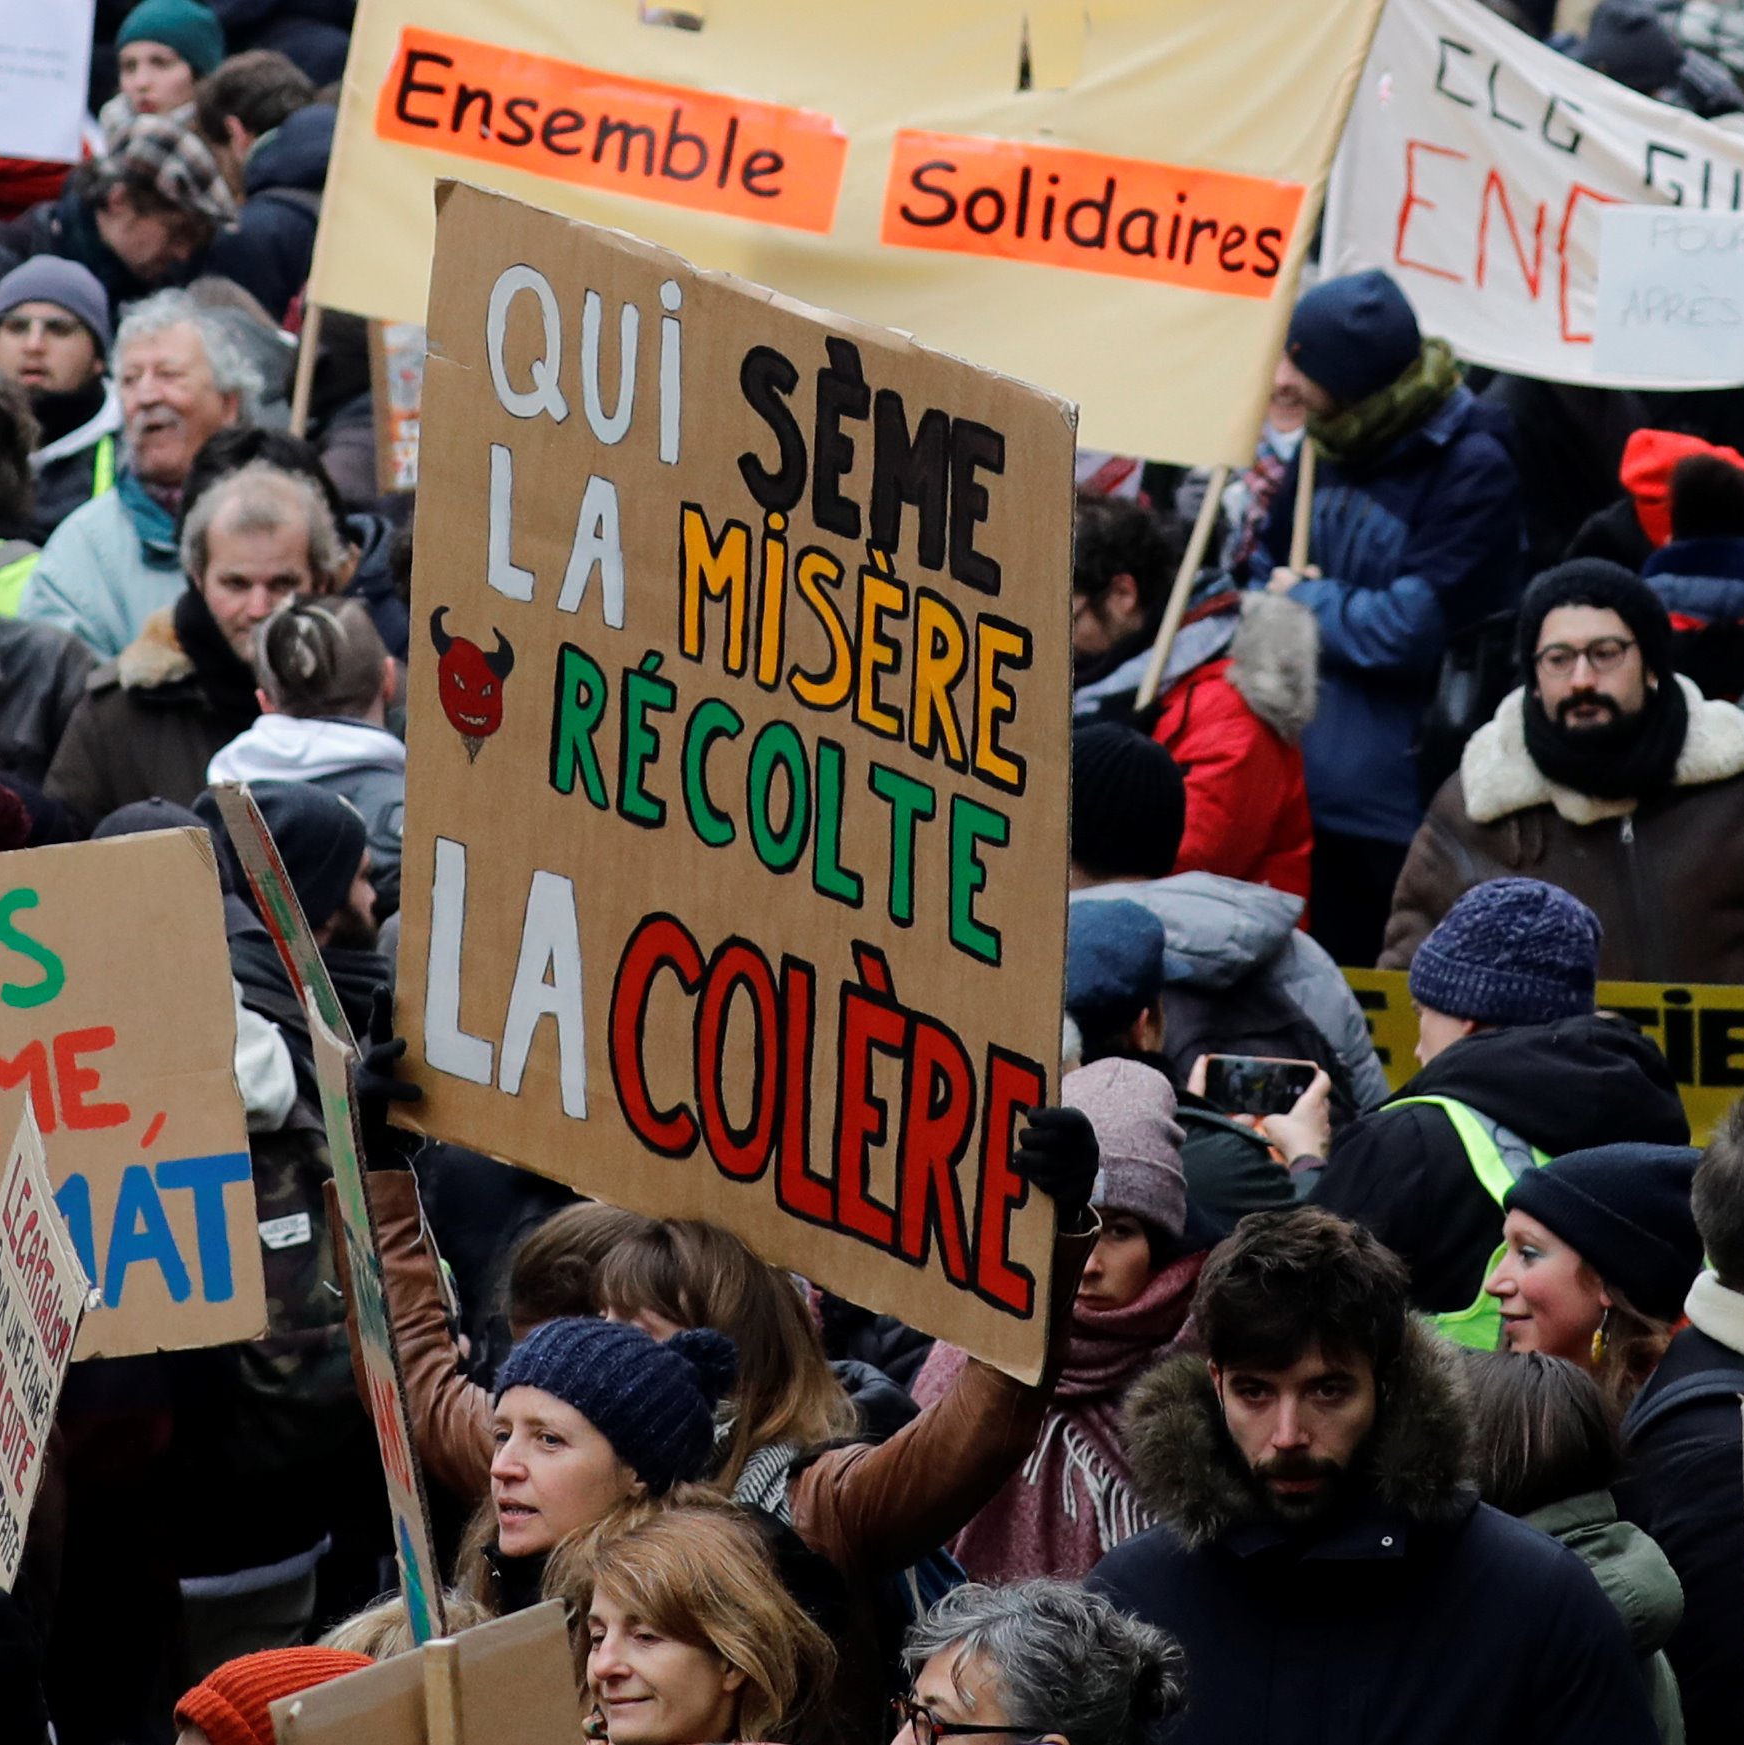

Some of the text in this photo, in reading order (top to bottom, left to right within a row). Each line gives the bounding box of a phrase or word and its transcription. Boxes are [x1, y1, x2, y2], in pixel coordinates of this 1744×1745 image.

[395, 49, 1284, 280] Ensemble Solidaires
[1436, 38, 1583, 154] CLG
[487, 443, 624, 629] LA
[739, 336, 1006, 597] SÈME
[549, 642, 1011, 966] RÉCOLTE
[424, 836, 1047, 1319] LA COLÈRE
